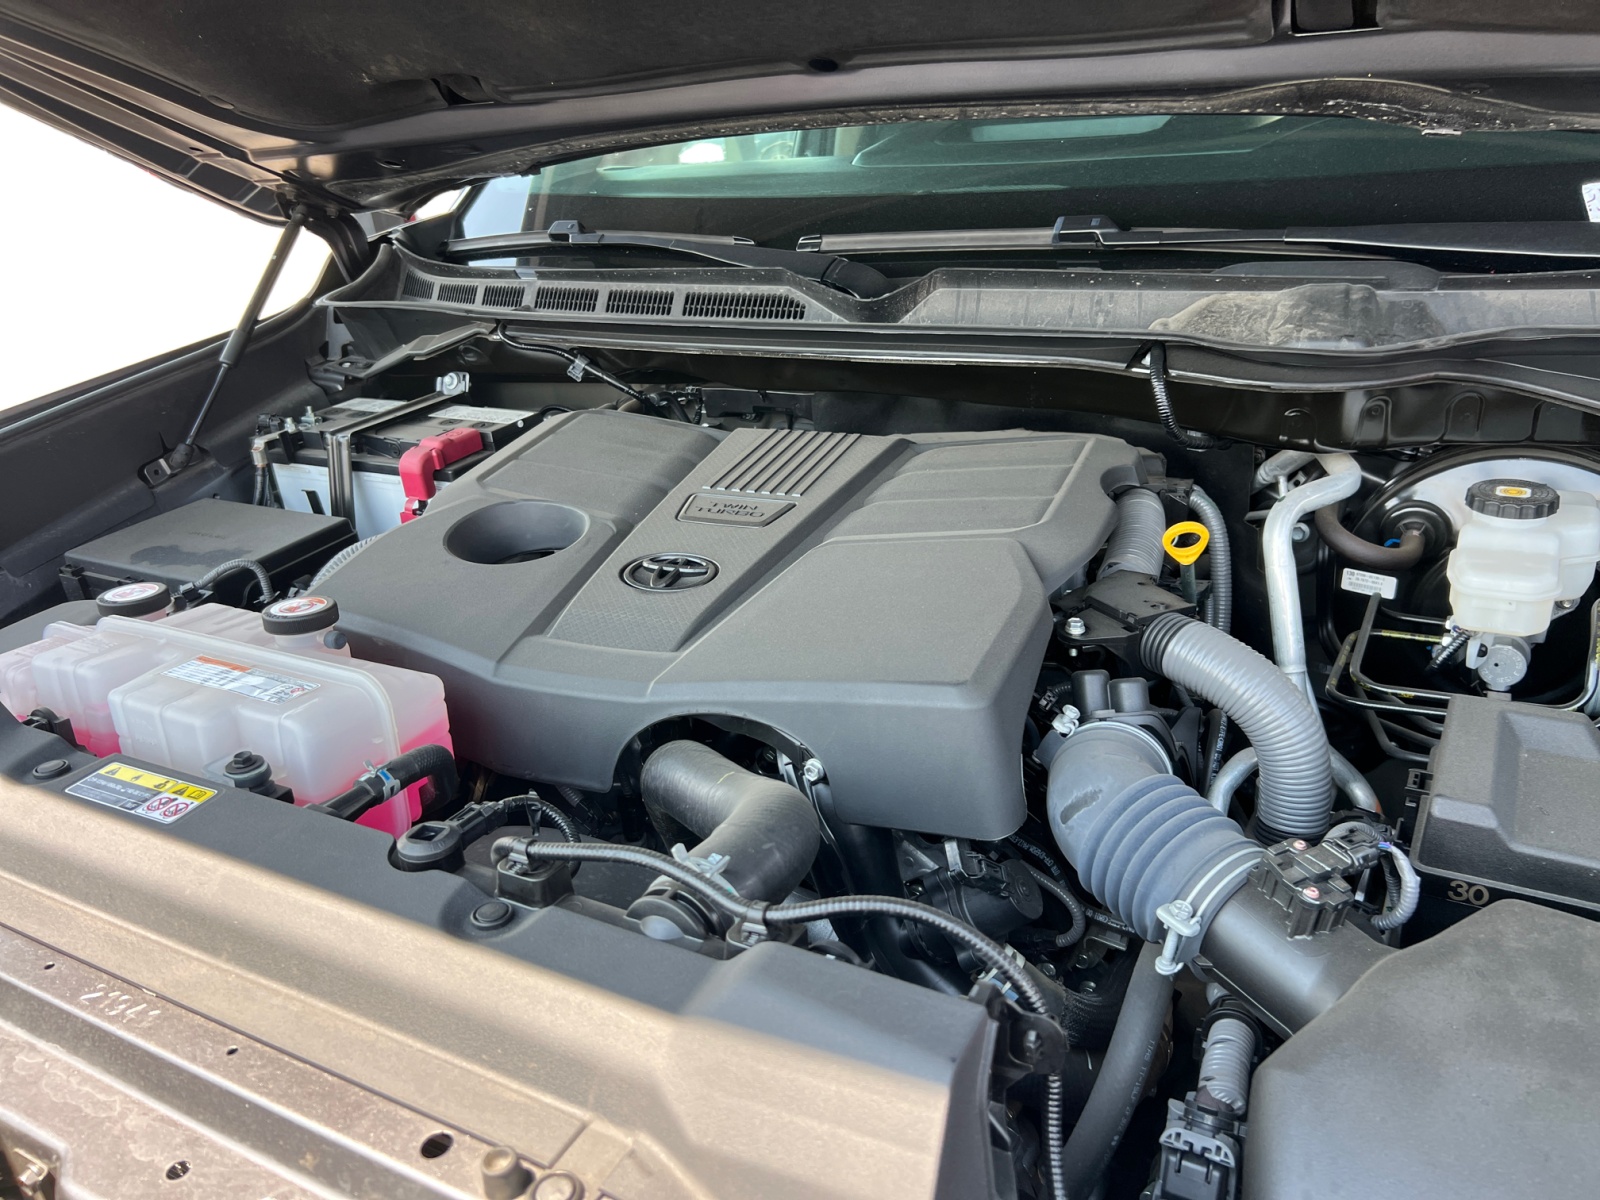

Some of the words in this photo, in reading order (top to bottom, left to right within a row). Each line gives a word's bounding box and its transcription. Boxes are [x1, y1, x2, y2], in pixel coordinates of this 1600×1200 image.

[710, 501, 758, 510] TWIN
[695, 506, 765, 517] TURBO
[1447, 880, 1490, 906] 30
